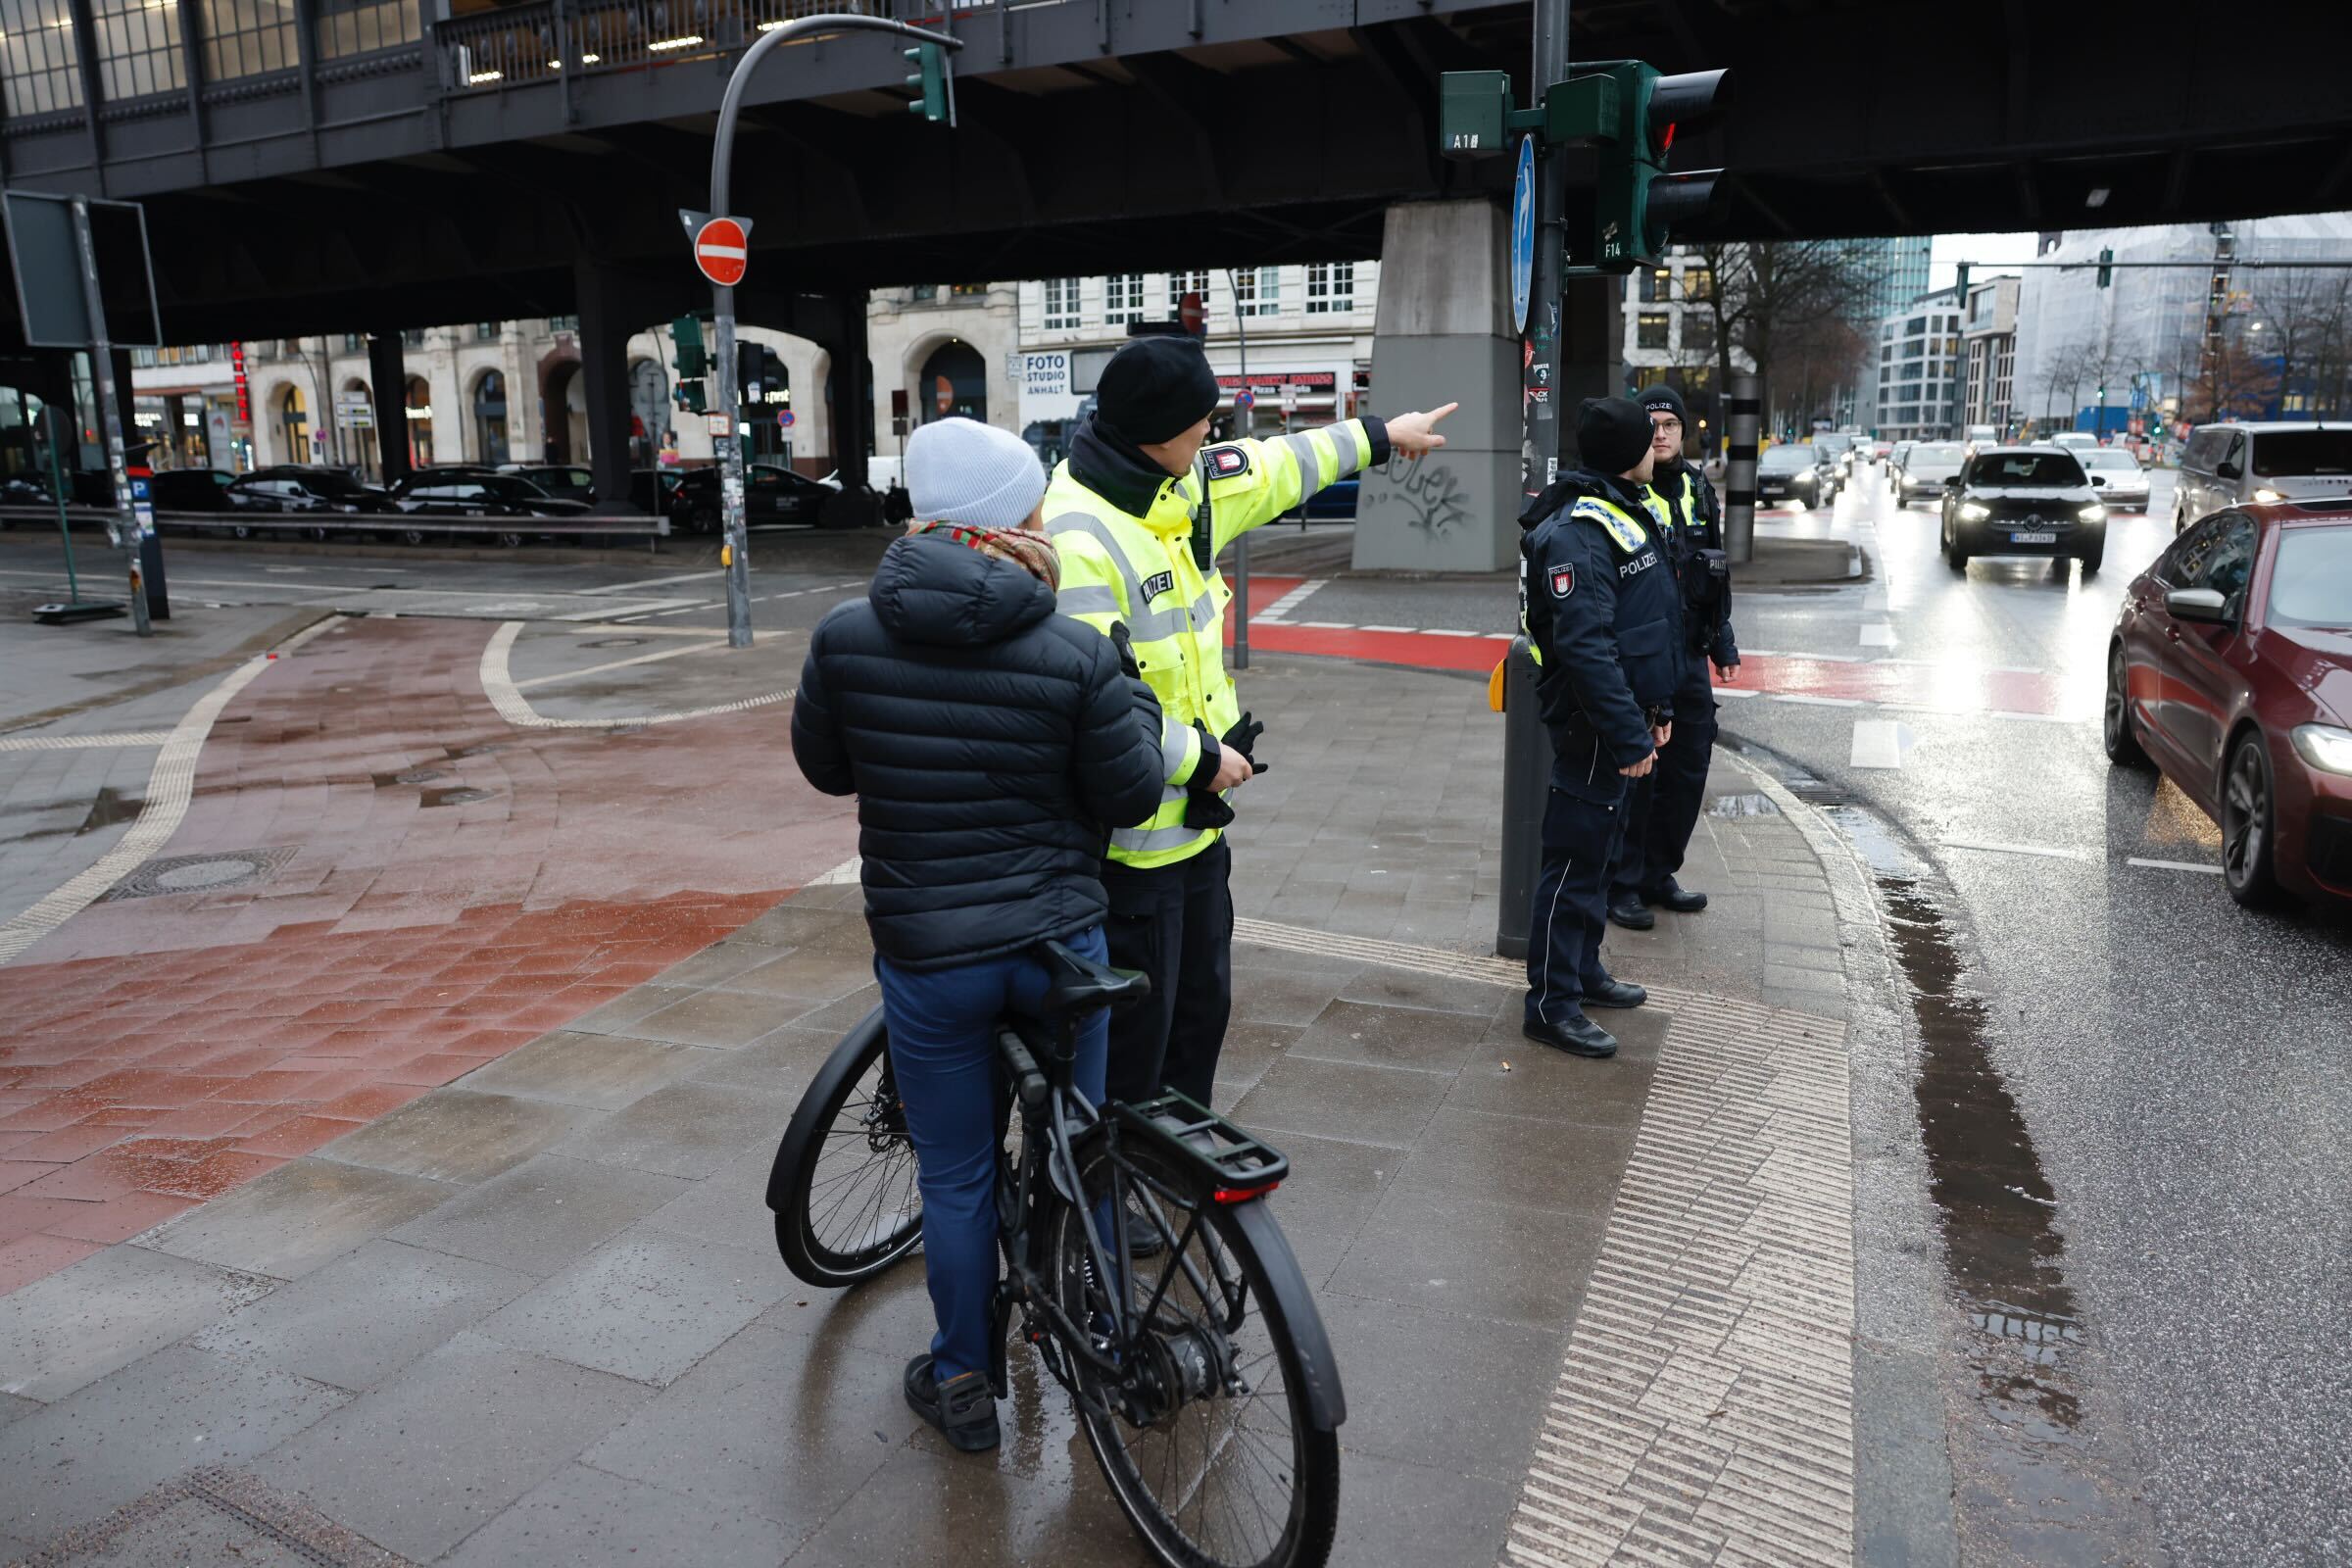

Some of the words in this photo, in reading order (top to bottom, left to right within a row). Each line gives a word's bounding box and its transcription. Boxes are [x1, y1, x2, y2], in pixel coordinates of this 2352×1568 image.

[1605, 242, 1621, 258] F14
[1026, 356, 1065, 370] FOTO
[1027, 371, 1065, 382] STUDIO
[1027, 385, 1064, 394] ANHALT
[1206, 452, 1220, 477] POLIZEI
[133, 481, 145, 497] P
[1550, 564, 1572, 576] POLIZEI
